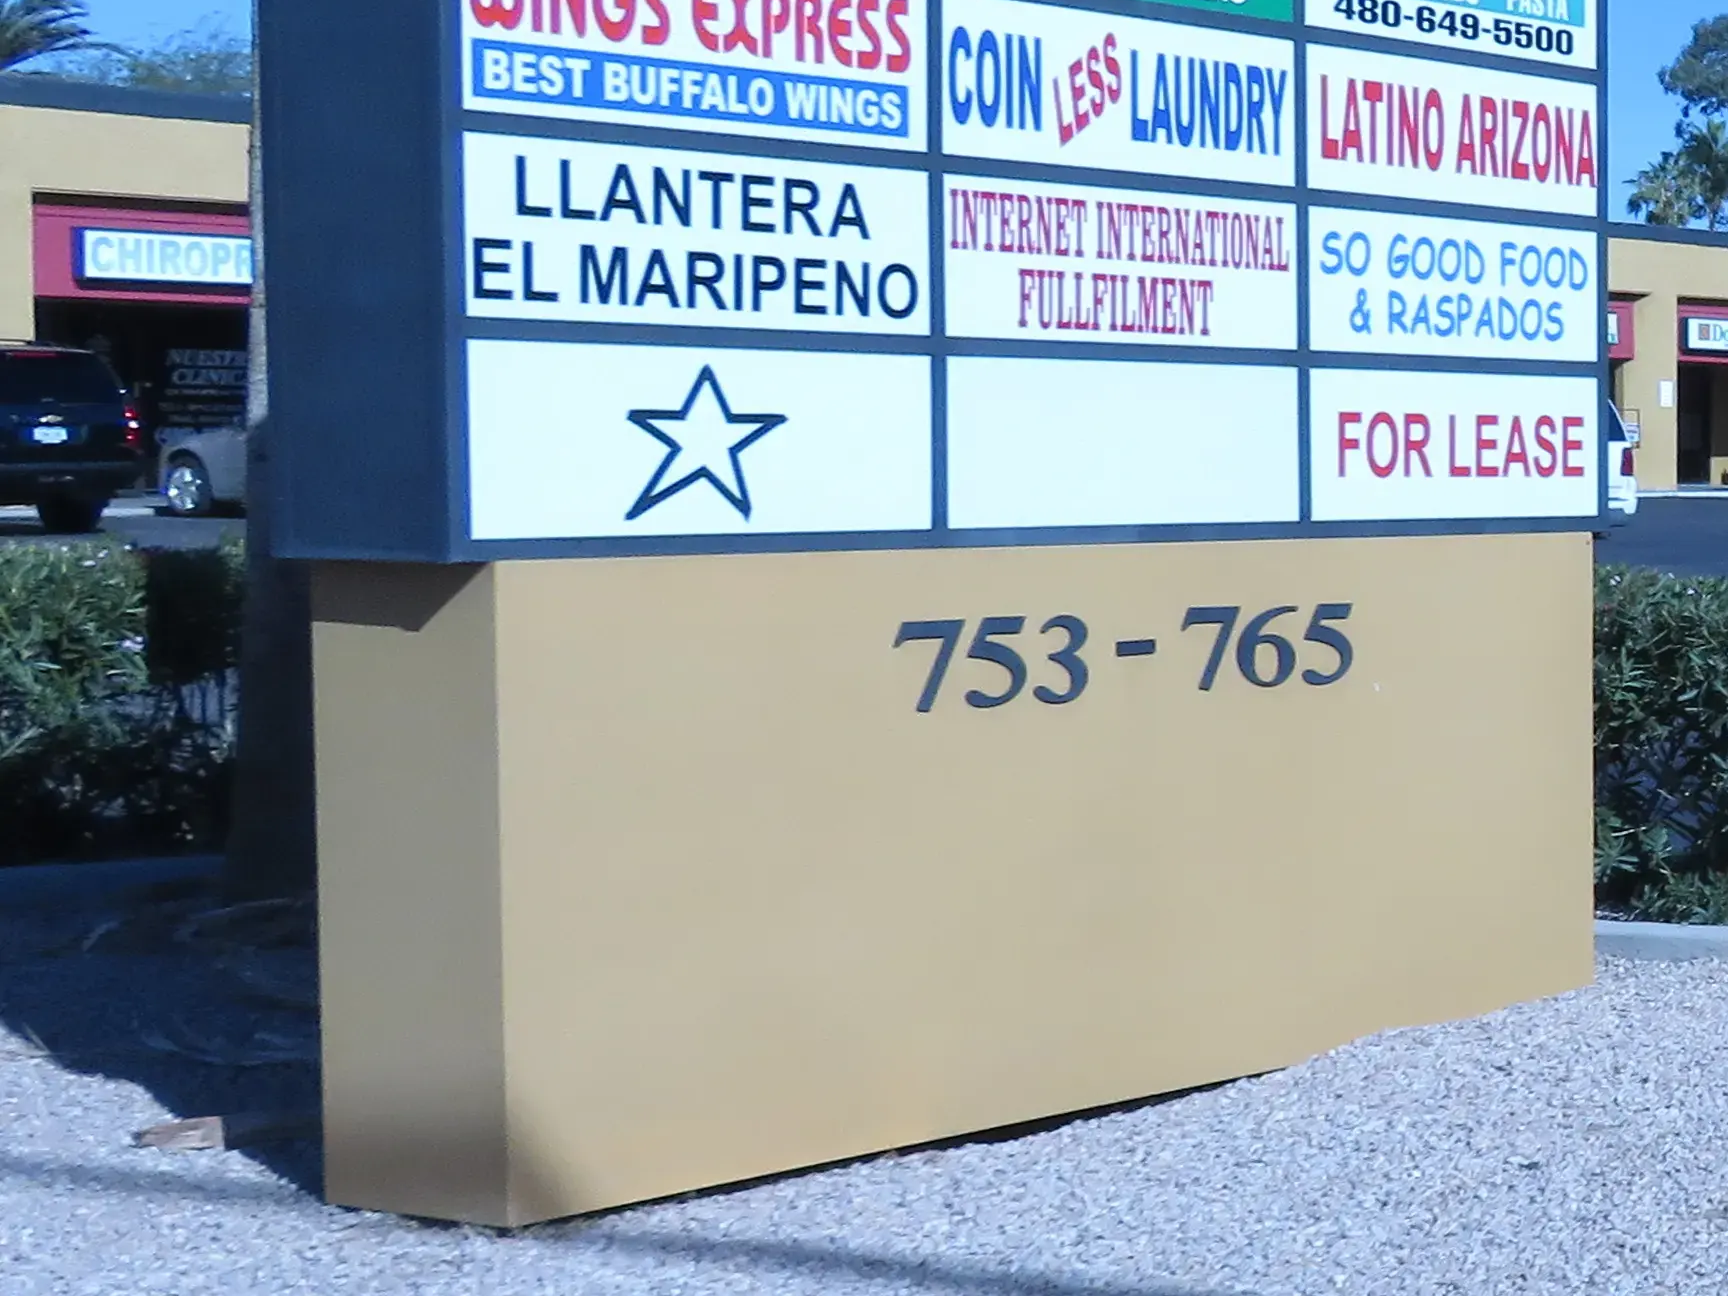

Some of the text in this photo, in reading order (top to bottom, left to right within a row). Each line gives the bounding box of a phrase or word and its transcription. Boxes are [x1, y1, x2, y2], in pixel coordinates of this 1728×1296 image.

[482, 48, 902, 131] BEST BUFFALO WINGS
[948, 25, 1288, 156] COIN LESS LAUNDRY
[1320, 74, 1598, 188] LATINO ARIZONA
[514, 153, 871, 240] LLANTERA
[949, 187, 1290, 273] INTERNET INTERNATIONAL
[472, 237, 920, 320] EL MARIPENO
[1017, 267, 1214, 337] FULLFILMENT
[1319, 230, 1588, 292] SO GOOD FOOD
[1349, 287, 1565, 343] & RASPADOS
[1337, 410, 1585, 479] FOR LEASE
